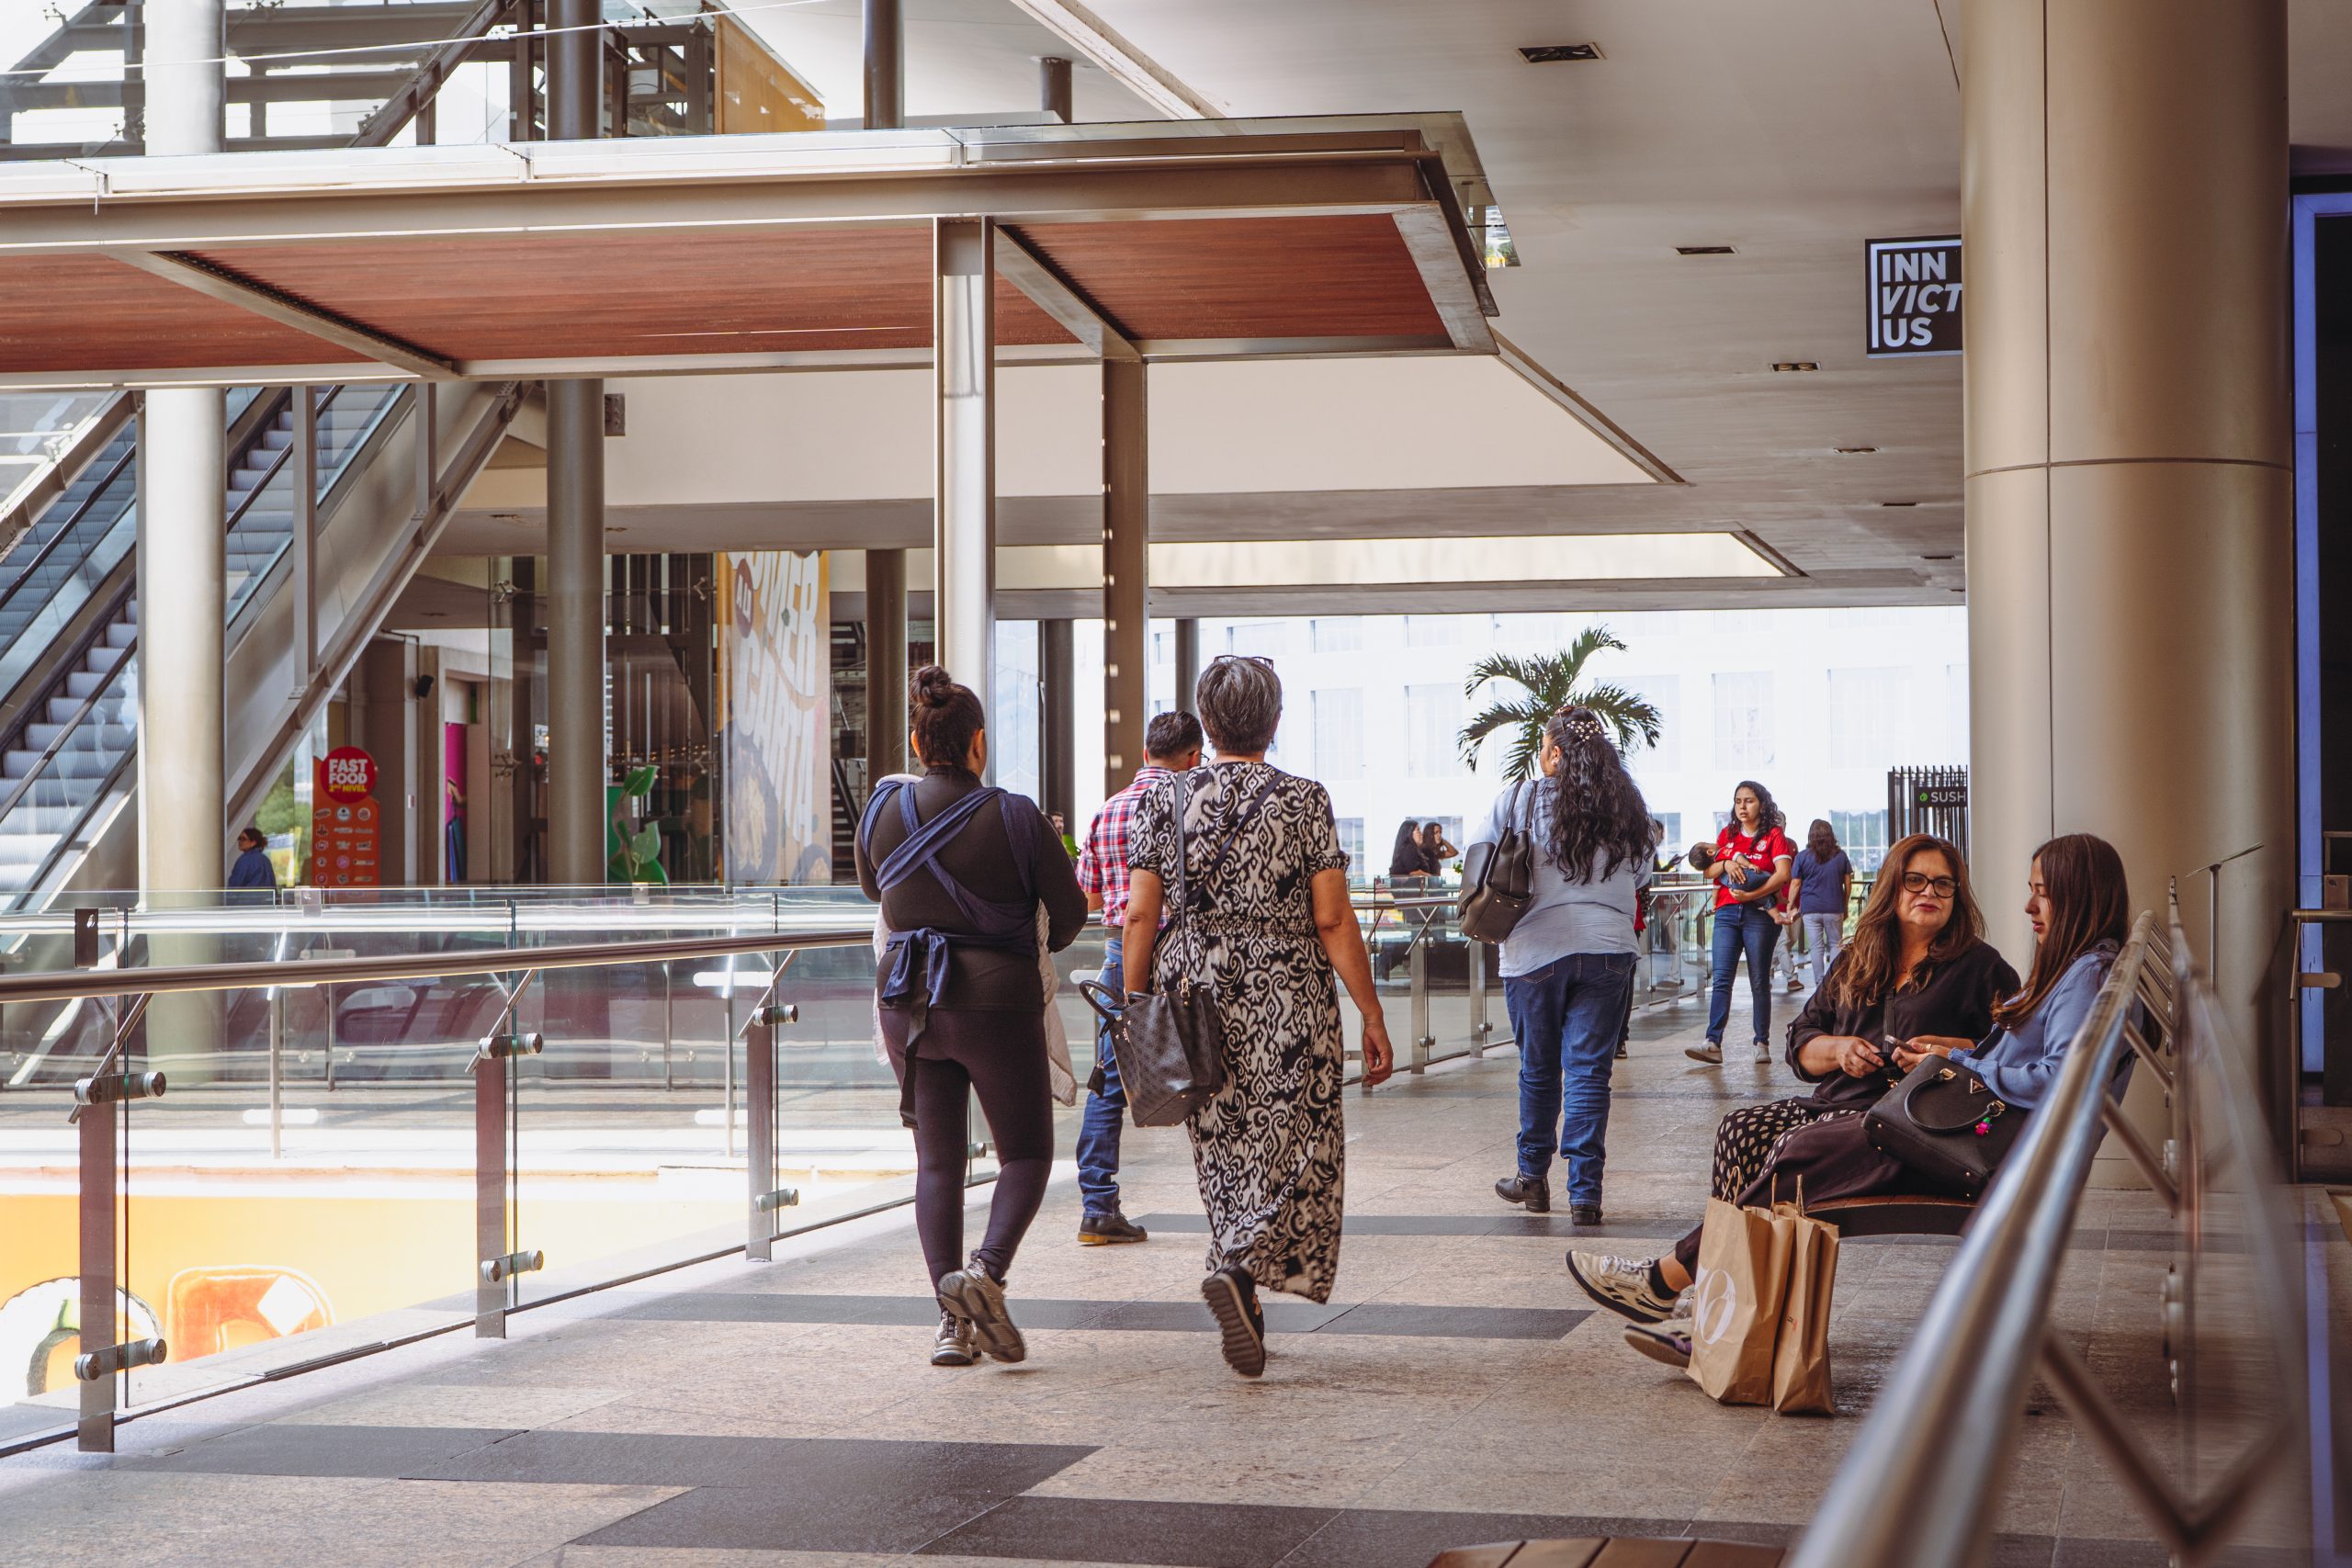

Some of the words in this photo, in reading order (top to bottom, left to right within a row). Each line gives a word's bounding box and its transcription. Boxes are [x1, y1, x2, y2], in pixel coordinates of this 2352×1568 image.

[1882, 251, 1946, 283] INN
[1883, 283, 1962, 315] VICT
[1883, 317, 1933, 347] US
[738, 628, 816, 847] CARTA
[329, 759, 368, 773] FAST
[329, 773, 368, 784] FOOD
[343, 784, 367, 793] NIVEL
